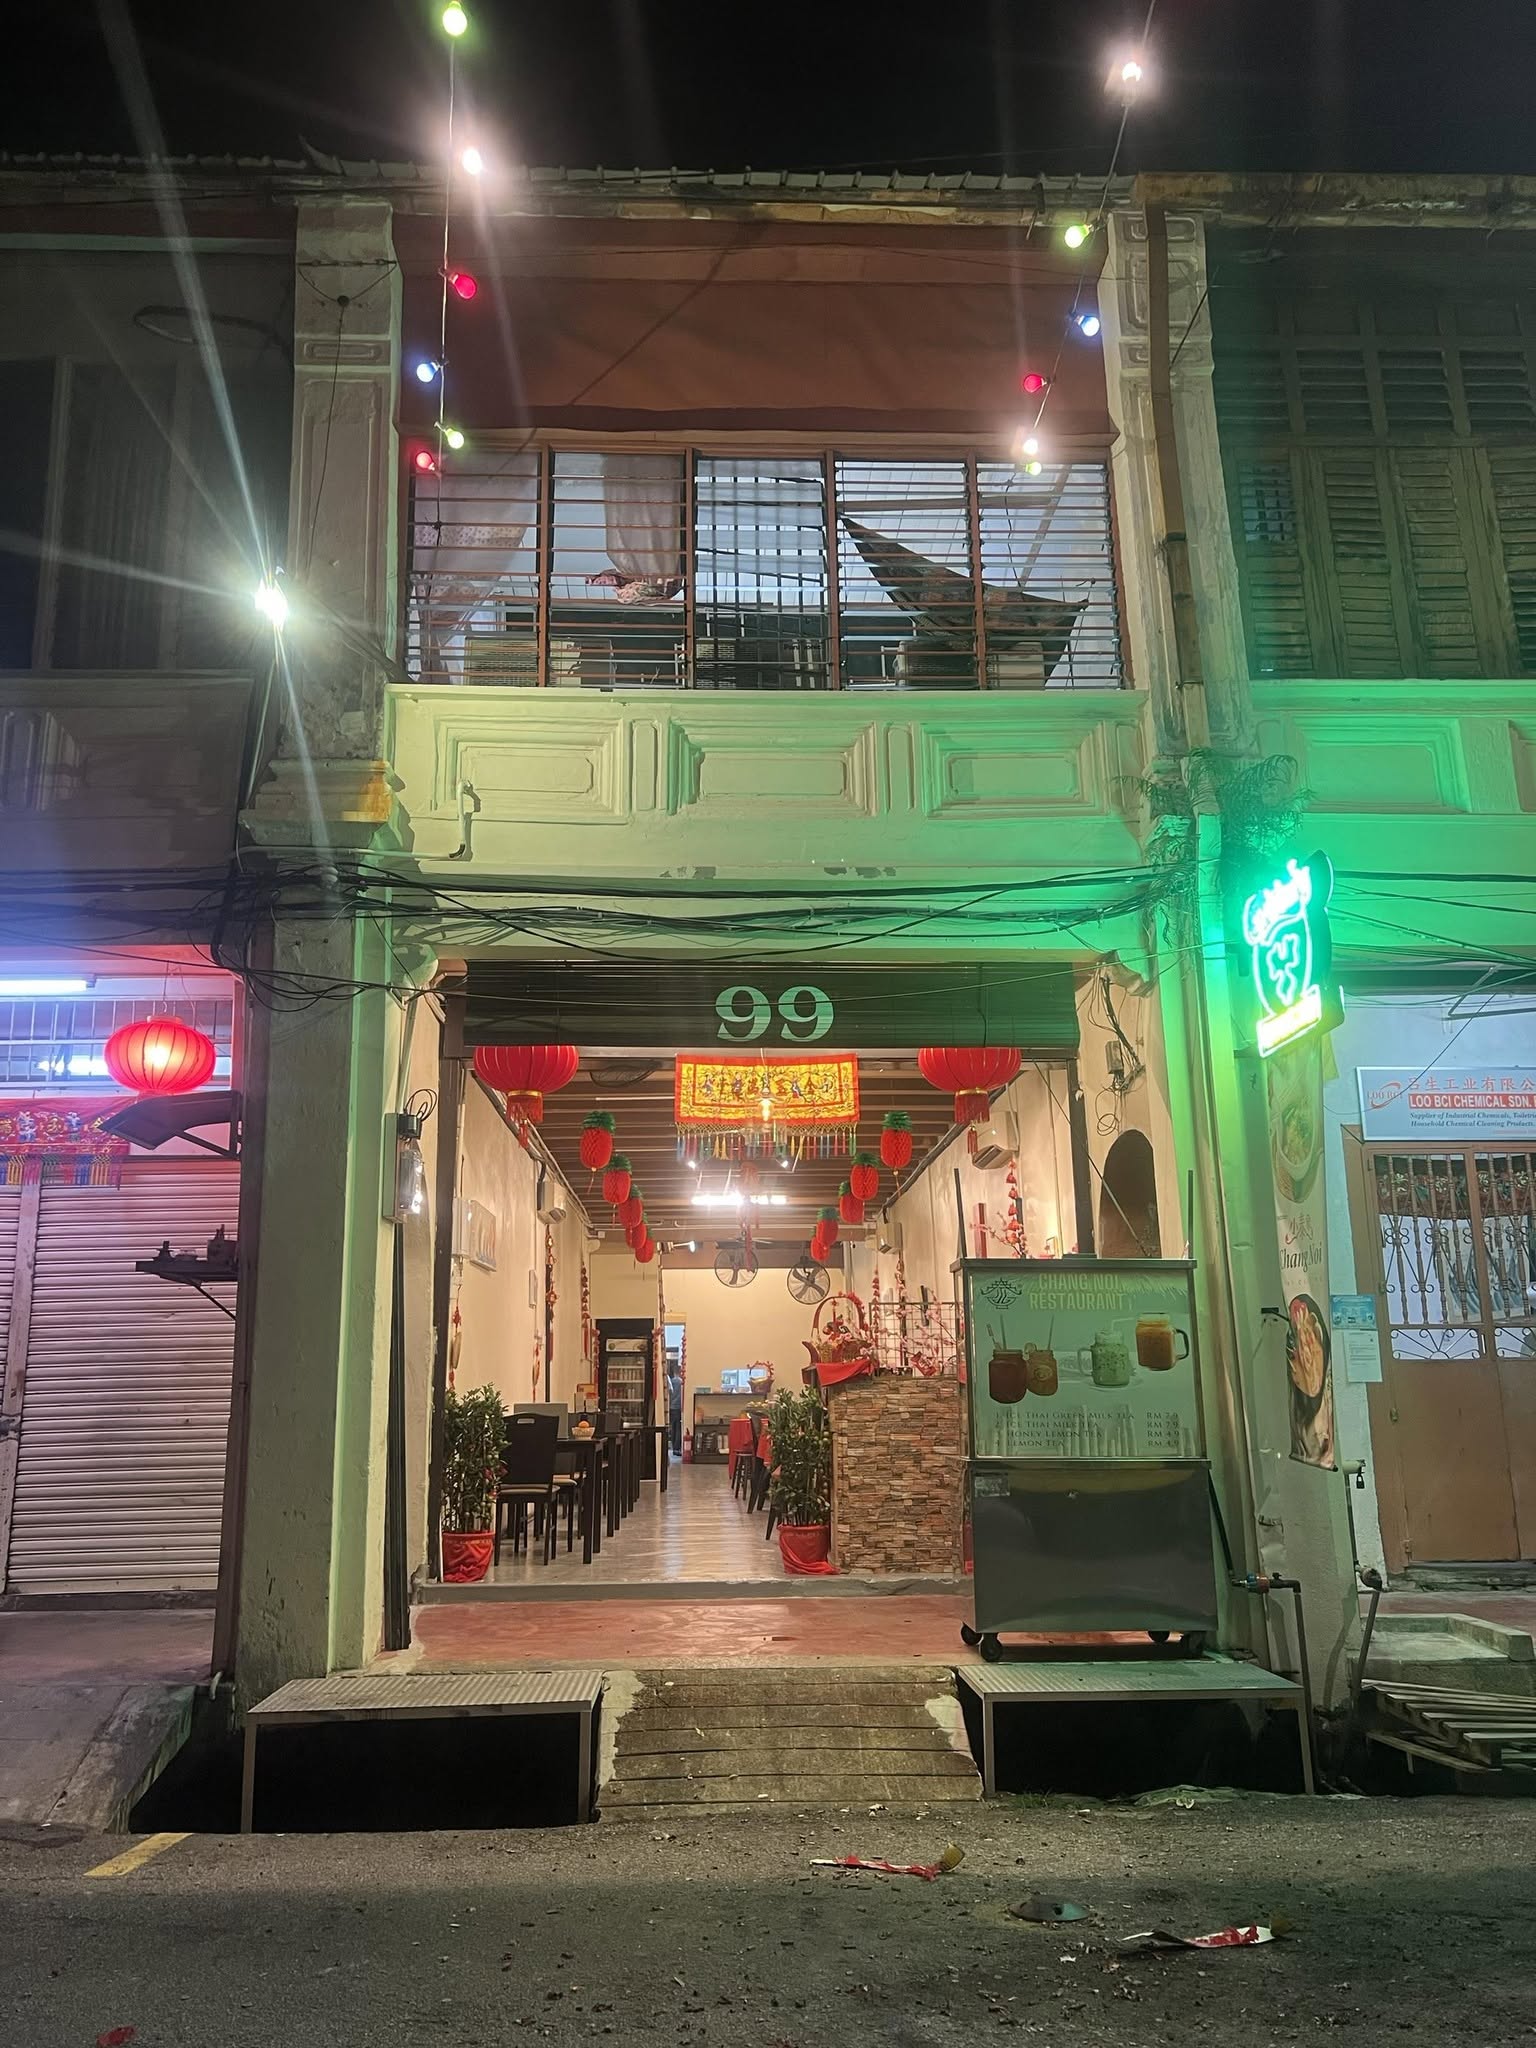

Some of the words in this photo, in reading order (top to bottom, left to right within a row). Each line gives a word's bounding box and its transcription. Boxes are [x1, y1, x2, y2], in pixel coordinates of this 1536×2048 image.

[715, 985, 835, 1042] 99
[1409, 1095, 1432, 1107] LOO
[1434, 1095, 1452, 1107] BCI
[1454, 1095, 1507, 1107] CHEMICAL
[1508, 1095, 1532, 1107] SDN.
[1410, 1112, 1436, 1120] Supplier
[1476, 1120, 1505, 1128] Cleaning
[1039, 1274, 1088, 1290] CHANG
[1030, 1293, 1127, 1310] RESTAURANT
